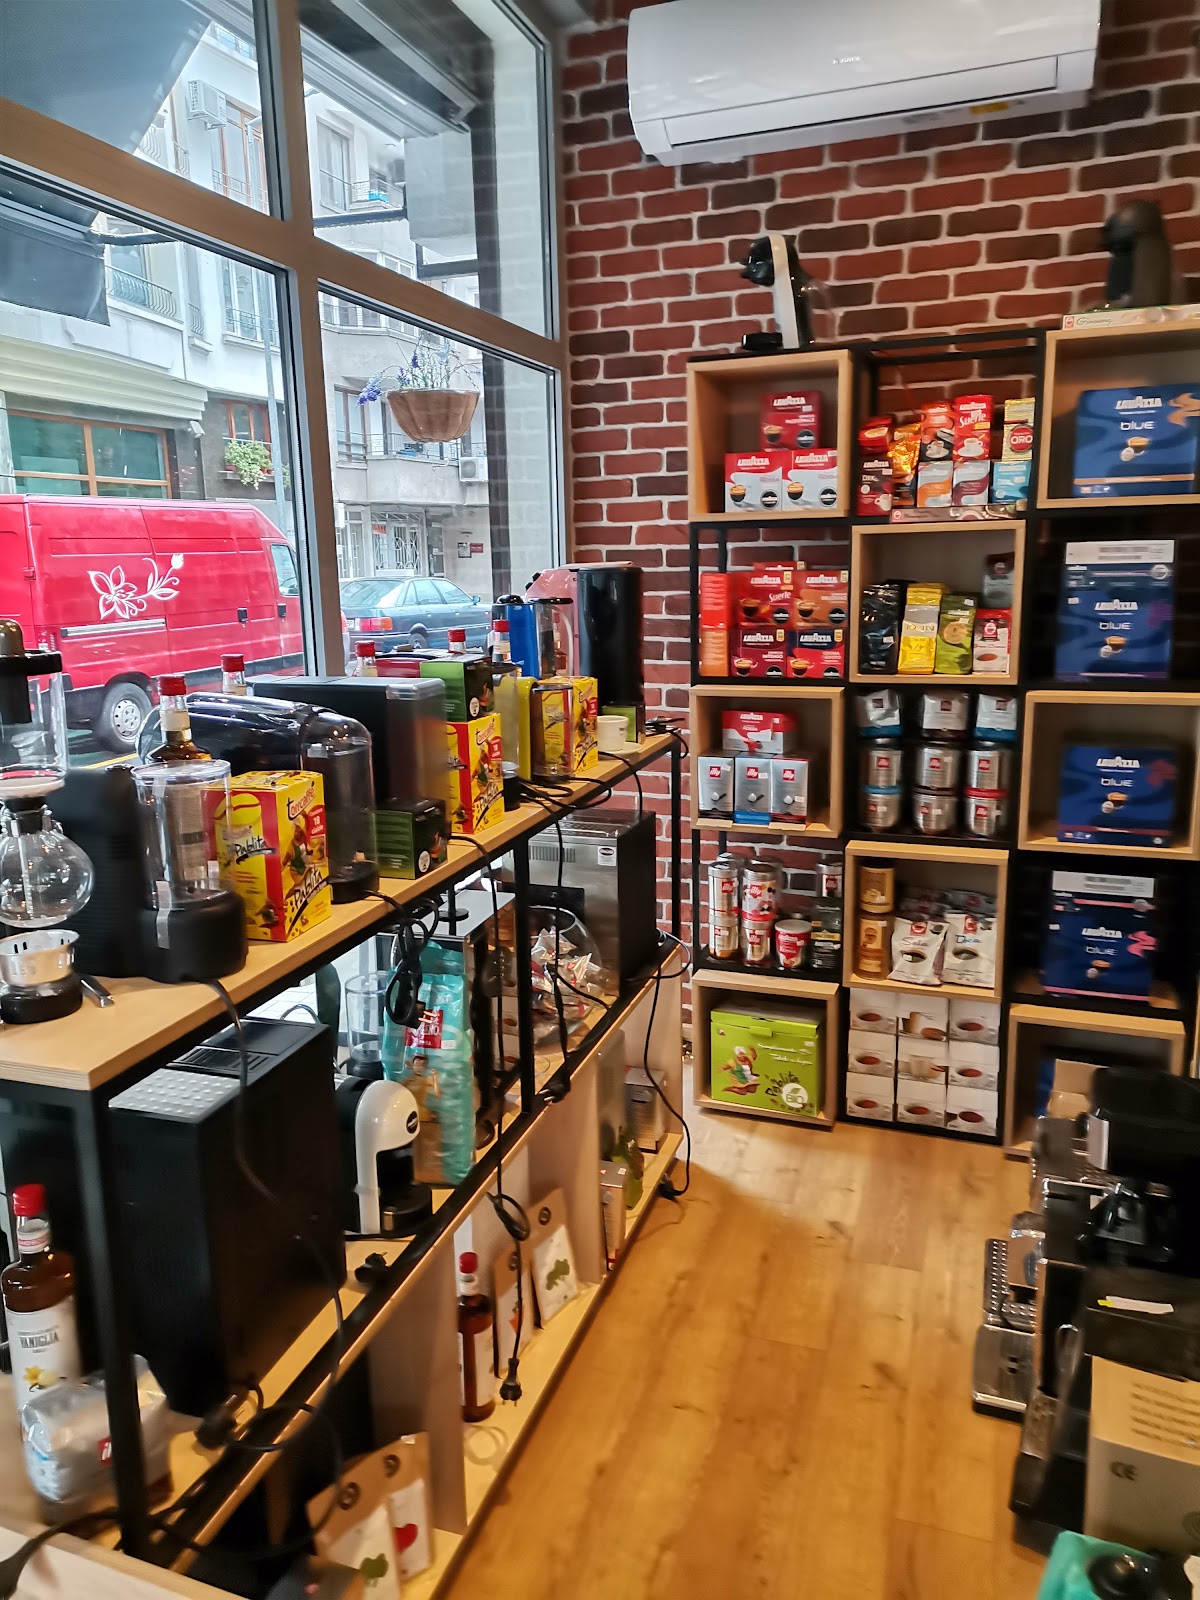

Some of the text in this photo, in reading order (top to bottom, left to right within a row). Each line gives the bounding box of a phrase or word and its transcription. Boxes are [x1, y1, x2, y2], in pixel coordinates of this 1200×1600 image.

[1115, 395, 1162, 410] LAVAZZA
[1120, 421, 1156, 431] blue
[1011, 435, 1033, 445] ORO
[769, 591, 791, 602] Suerte
[1094, 599, 1138, 611] LAVAZZA
[1099, 622, 1133, 630] blue
[1096, 756, 1140, 768] LAVAZZA
[710, 767, 721, 777] illy
[747, 768, 758, 777] illy
[783, 770, 794, 779] illy
[313, 816, 320, 826] 18
[235, 835, 267, 857] Pablita
[294, 864, 323, 909] Pablita
[722, 883, 733, 892] illy
[750, 886, 762, 896] illy
[1081, 927, 1122, 938] LAVAZZA
[749, 934, 760, 944] illy
[786, 1093, 804, 1105] BIO
[19, 1331, 59, 1349] VANIGLIA
